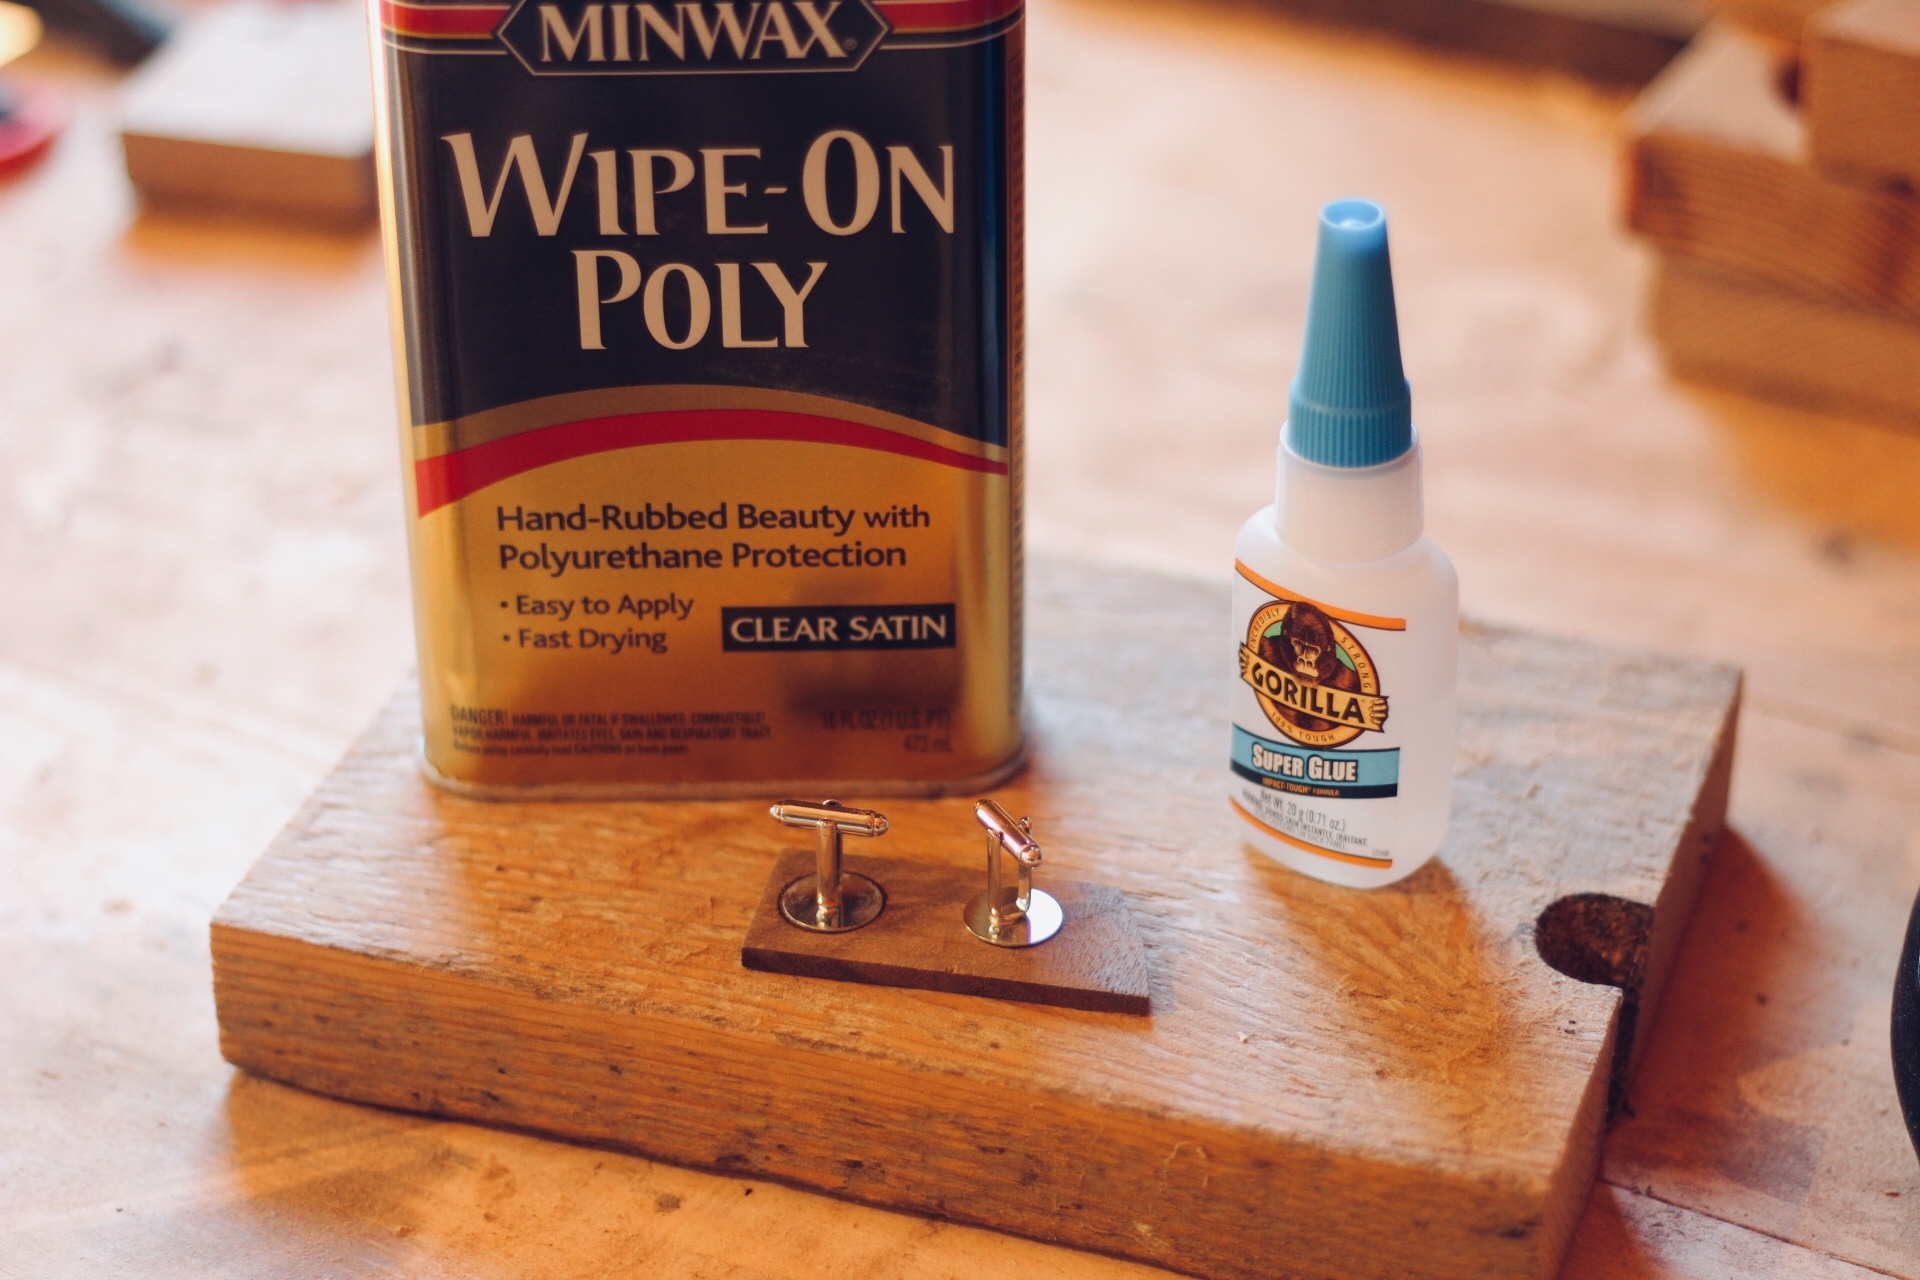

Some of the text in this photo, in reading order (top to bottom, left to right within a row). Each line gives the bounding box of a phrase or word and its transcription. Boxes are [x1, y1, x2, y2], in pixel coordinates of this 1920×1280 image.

[539, 1, 848, 62] MINWAX
[441, 130, 954, 238] WIPE-ON
[571, 250, 828, 351] POLY
[496, 502, 930, 536] Hand-Rubbed Beauty with
[500, 542, 907, 577] Polyurethane Protection
[516, 594, 694, 620] Easy to Apply
[519, 629, 668, 654] Fast Drying
[730, 614, 947, 643] CLEAR SATIN
[1251, 608, 1280, 649] INCREDIBLY
[1341, 637, 1372, 688] STRONG
[1251, 662, 1365, 724] GORILLA
[451, 704, 508, 725] DANGER!
[579, 712, 606, 725] FATAL
[1271, 711, 1335, 742] 100% TOUGH
[1252, 743, 1357, 782] SUPER GLUE
[1313, 788, 1340, 796] FORMULA
[1287, 802, 1297, 816] 20
[1299, 809, 1304, 822] g
[1306, 809, 1326, 826] (0.71
